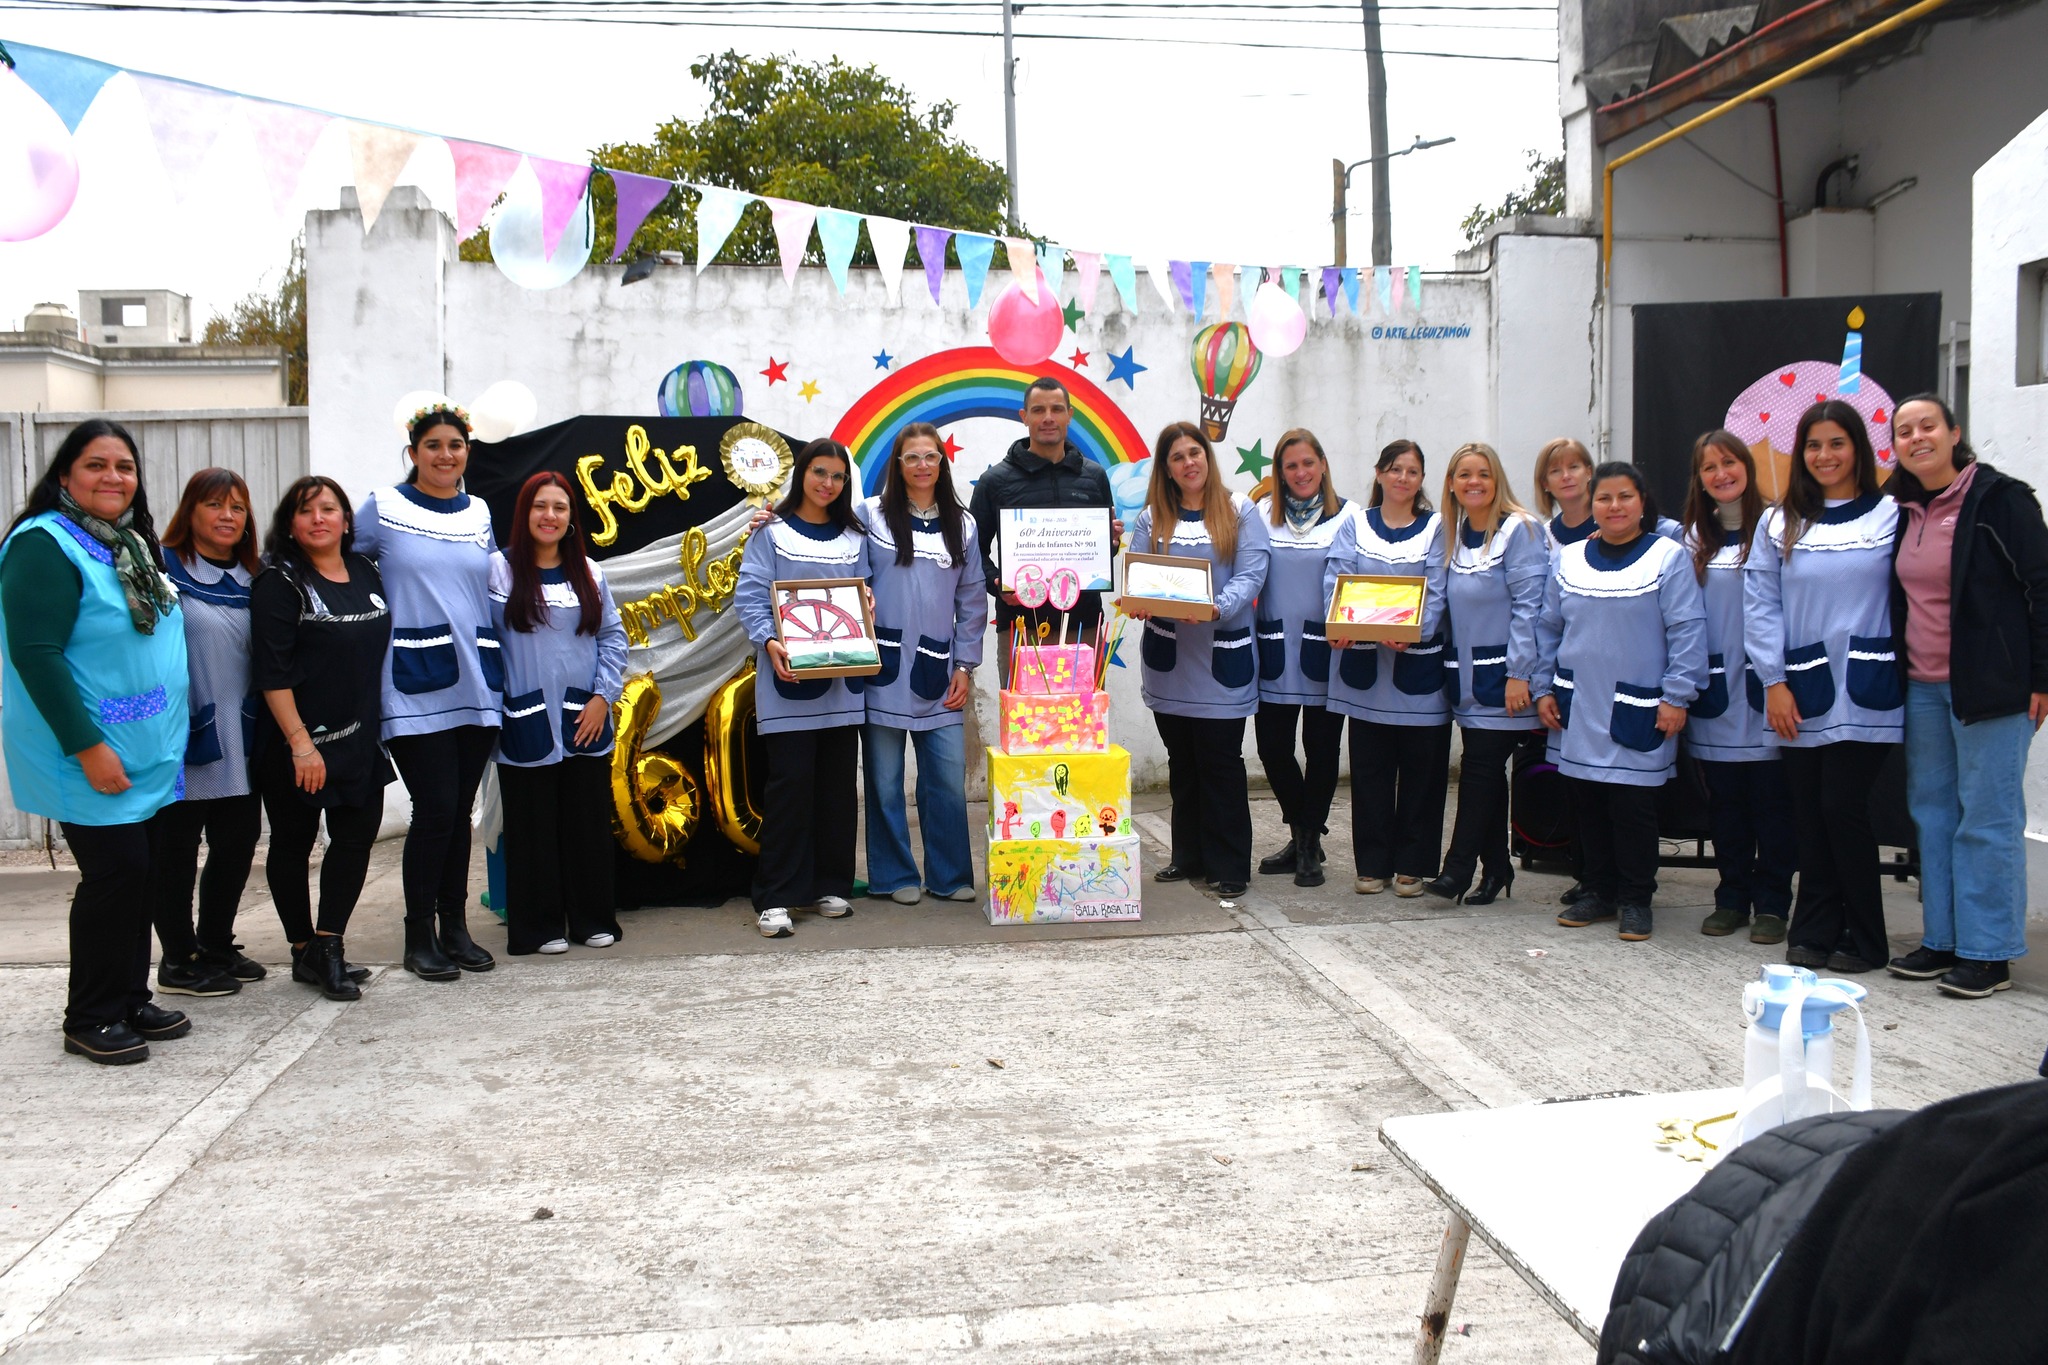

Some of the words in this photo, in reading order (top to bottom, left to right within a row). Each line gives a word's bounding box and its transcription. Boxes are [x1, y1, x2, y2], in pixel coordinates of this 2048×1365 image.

[1037, 527, 1092, 537] Aniversario
[1015, 541, 1036, 550] Jardín
[1014, 564, 1081, 611] 60
[1075, 904, 1099, 917] SALA
[1100, 903, 1123, 918] ROSA
